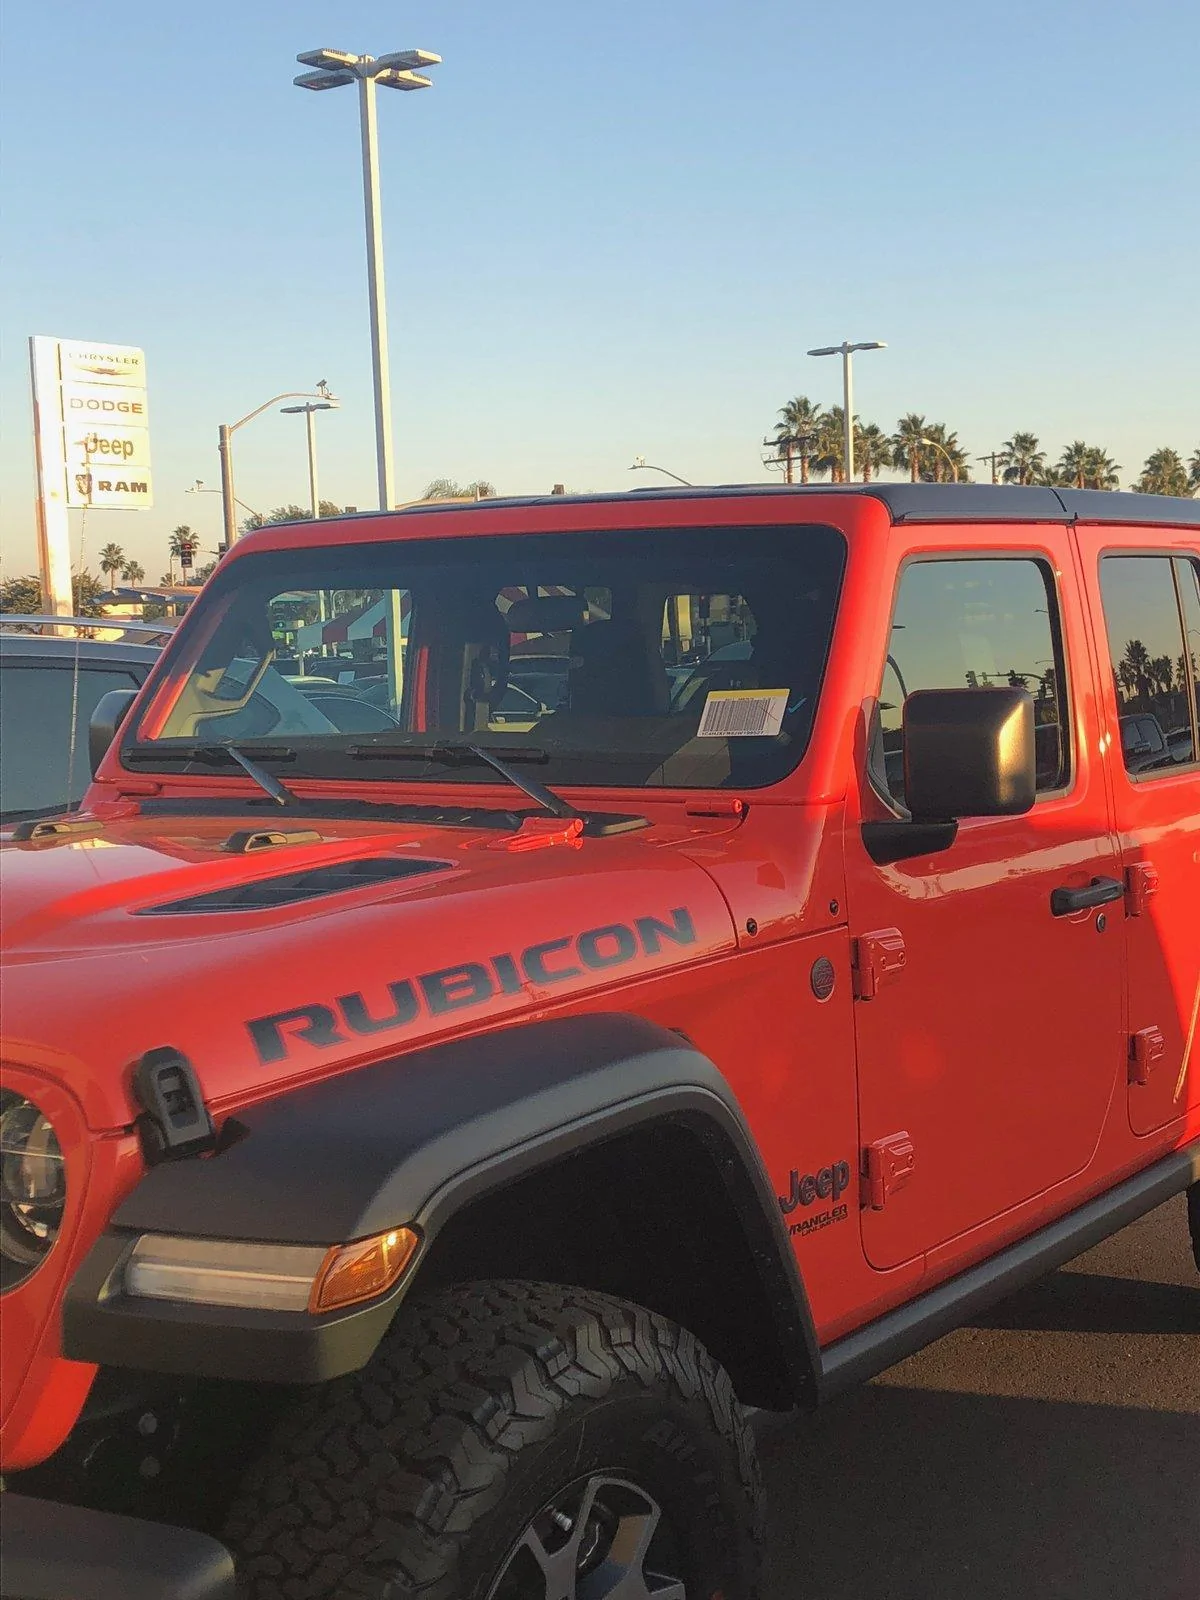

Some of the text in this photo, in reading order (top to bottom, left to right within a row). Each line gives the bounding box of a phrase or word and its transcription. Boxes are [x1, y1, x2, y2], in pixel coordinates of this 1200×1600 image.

[70, 398, 143, 414] DODGE
[85, 434, 134, 460] Jeep
[98, 481, 148, 493] RAM
[246, 907, 697, 1066] RUBICON
[779, 1160, 849, 1214] Jeep
